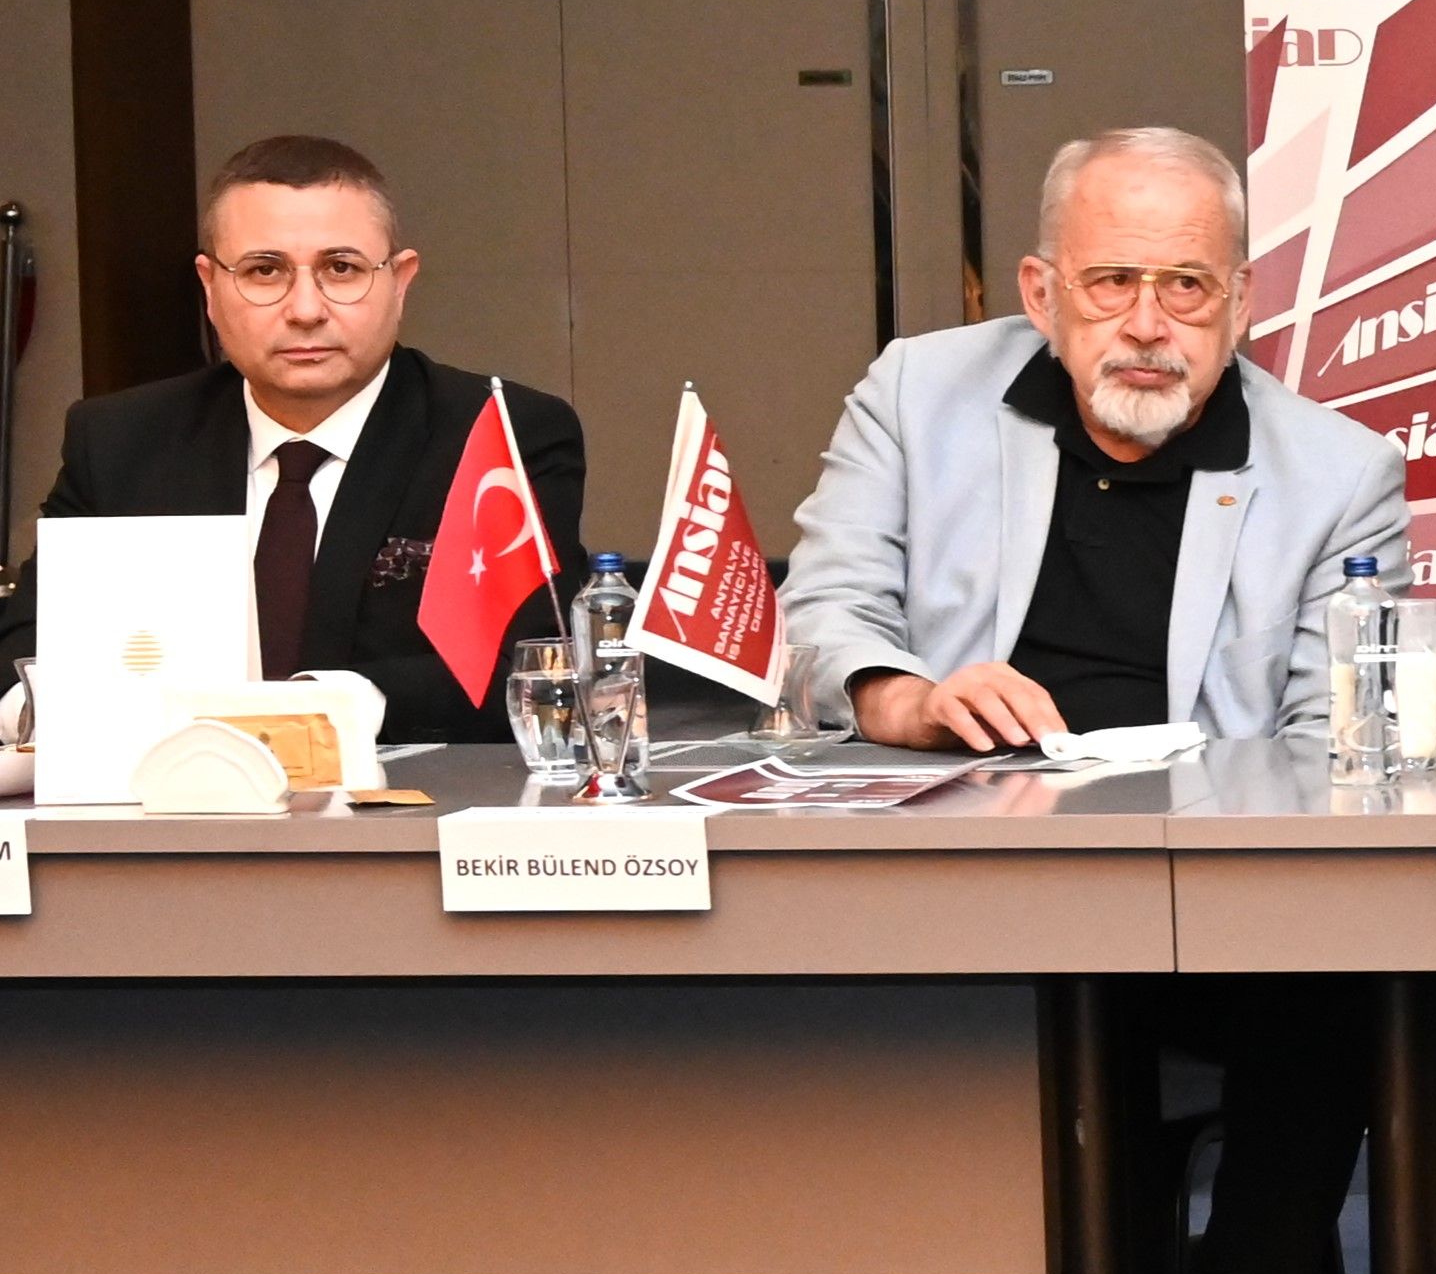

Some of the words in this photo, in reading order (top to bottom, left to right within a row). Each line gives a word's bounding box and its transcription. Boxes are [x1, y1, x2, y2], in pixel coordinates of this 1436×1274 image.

[711, 540, 742, 620] ANTALYA
[456, 851, 519, 877] BEKİR
[527, 851, 616, 876] BÜLEND
[624, 851, 698, 876] ÖZSOY
